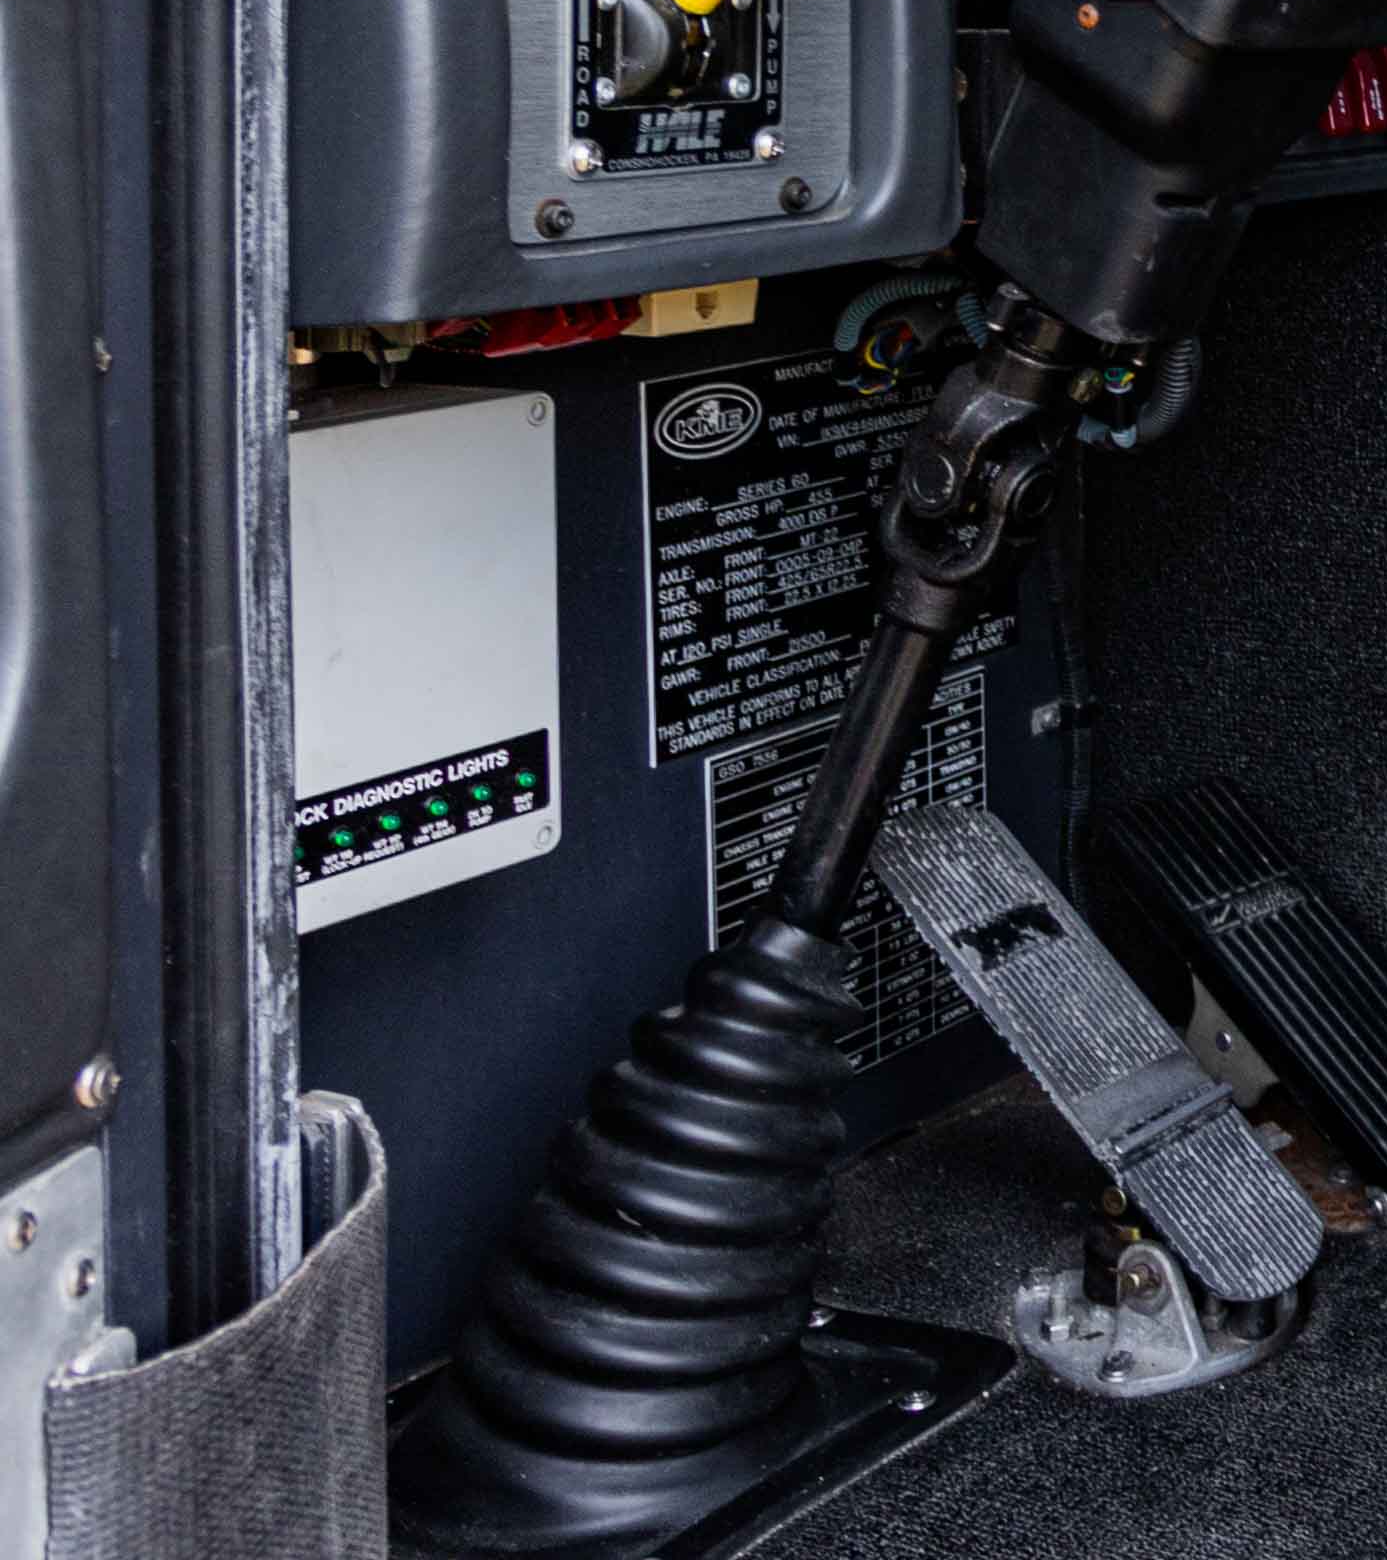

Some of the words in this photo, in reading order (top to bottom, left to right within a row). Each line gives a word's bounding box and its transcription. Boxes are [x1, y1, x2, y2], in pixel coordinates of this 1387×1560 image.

[576, 46, 591, 127] ROAD
[766, 39, 778, 114] PUMP
[774, 358, 834, 381] MANUFACT
[674, 407, 744, 443] KME
[768, 411, 799, 431] DATE
[802, 407, 818, 424] OF
[655, 496, 709, 522] ENGINE:
[737, 477, 785, 502] SERIES
[715, 504, 759, 528] GROSS
[658, 523, 756, 563] TRANSMISSION:
[657, 565, 694, 588] AXLE:
[724, 546, 766, 570] FRONT:
[657, 585, 689, 607] SER.
[724, 563, 767, 588] FRONT:
[658, 618, 697, 642] RIMS:
[725, 597, 767, 622] FRONT:
[659, 599, 702, 624] TIRES:
[724, 581, 767, 605] FRONT:
[660, 650, 676, 667] AT
[711, 633, 732, 652] PSI
[736, 619, 782, 645] SINGLE
[660, 666, 702, 691] GAWR:
[726, 646, 770, 673] FRONT:
[688, 678, 741, 709] VEHICLE
[745, 646, 840, 690] CLASSIFICATION:
[656, 720, 685, 742] THIS
[688, 704, 736, 733] VEHICLE
[739, 683, 800, 716] CONFORMS
[805, 678, 818, 694] TO
[822, 672, 840, 689] ALL
[669, 720, 736, 755] STANDARDS
[738, 715, 751, 732] IN
[756, 701, 795, 726] EFFECT
[799, 695, 816, 711] ON
[819, 684, 846, 705] DATE
[333, 768, 443, 816] DIAGNOSTIC
[447, 749, 509, 782] LIGHTS
